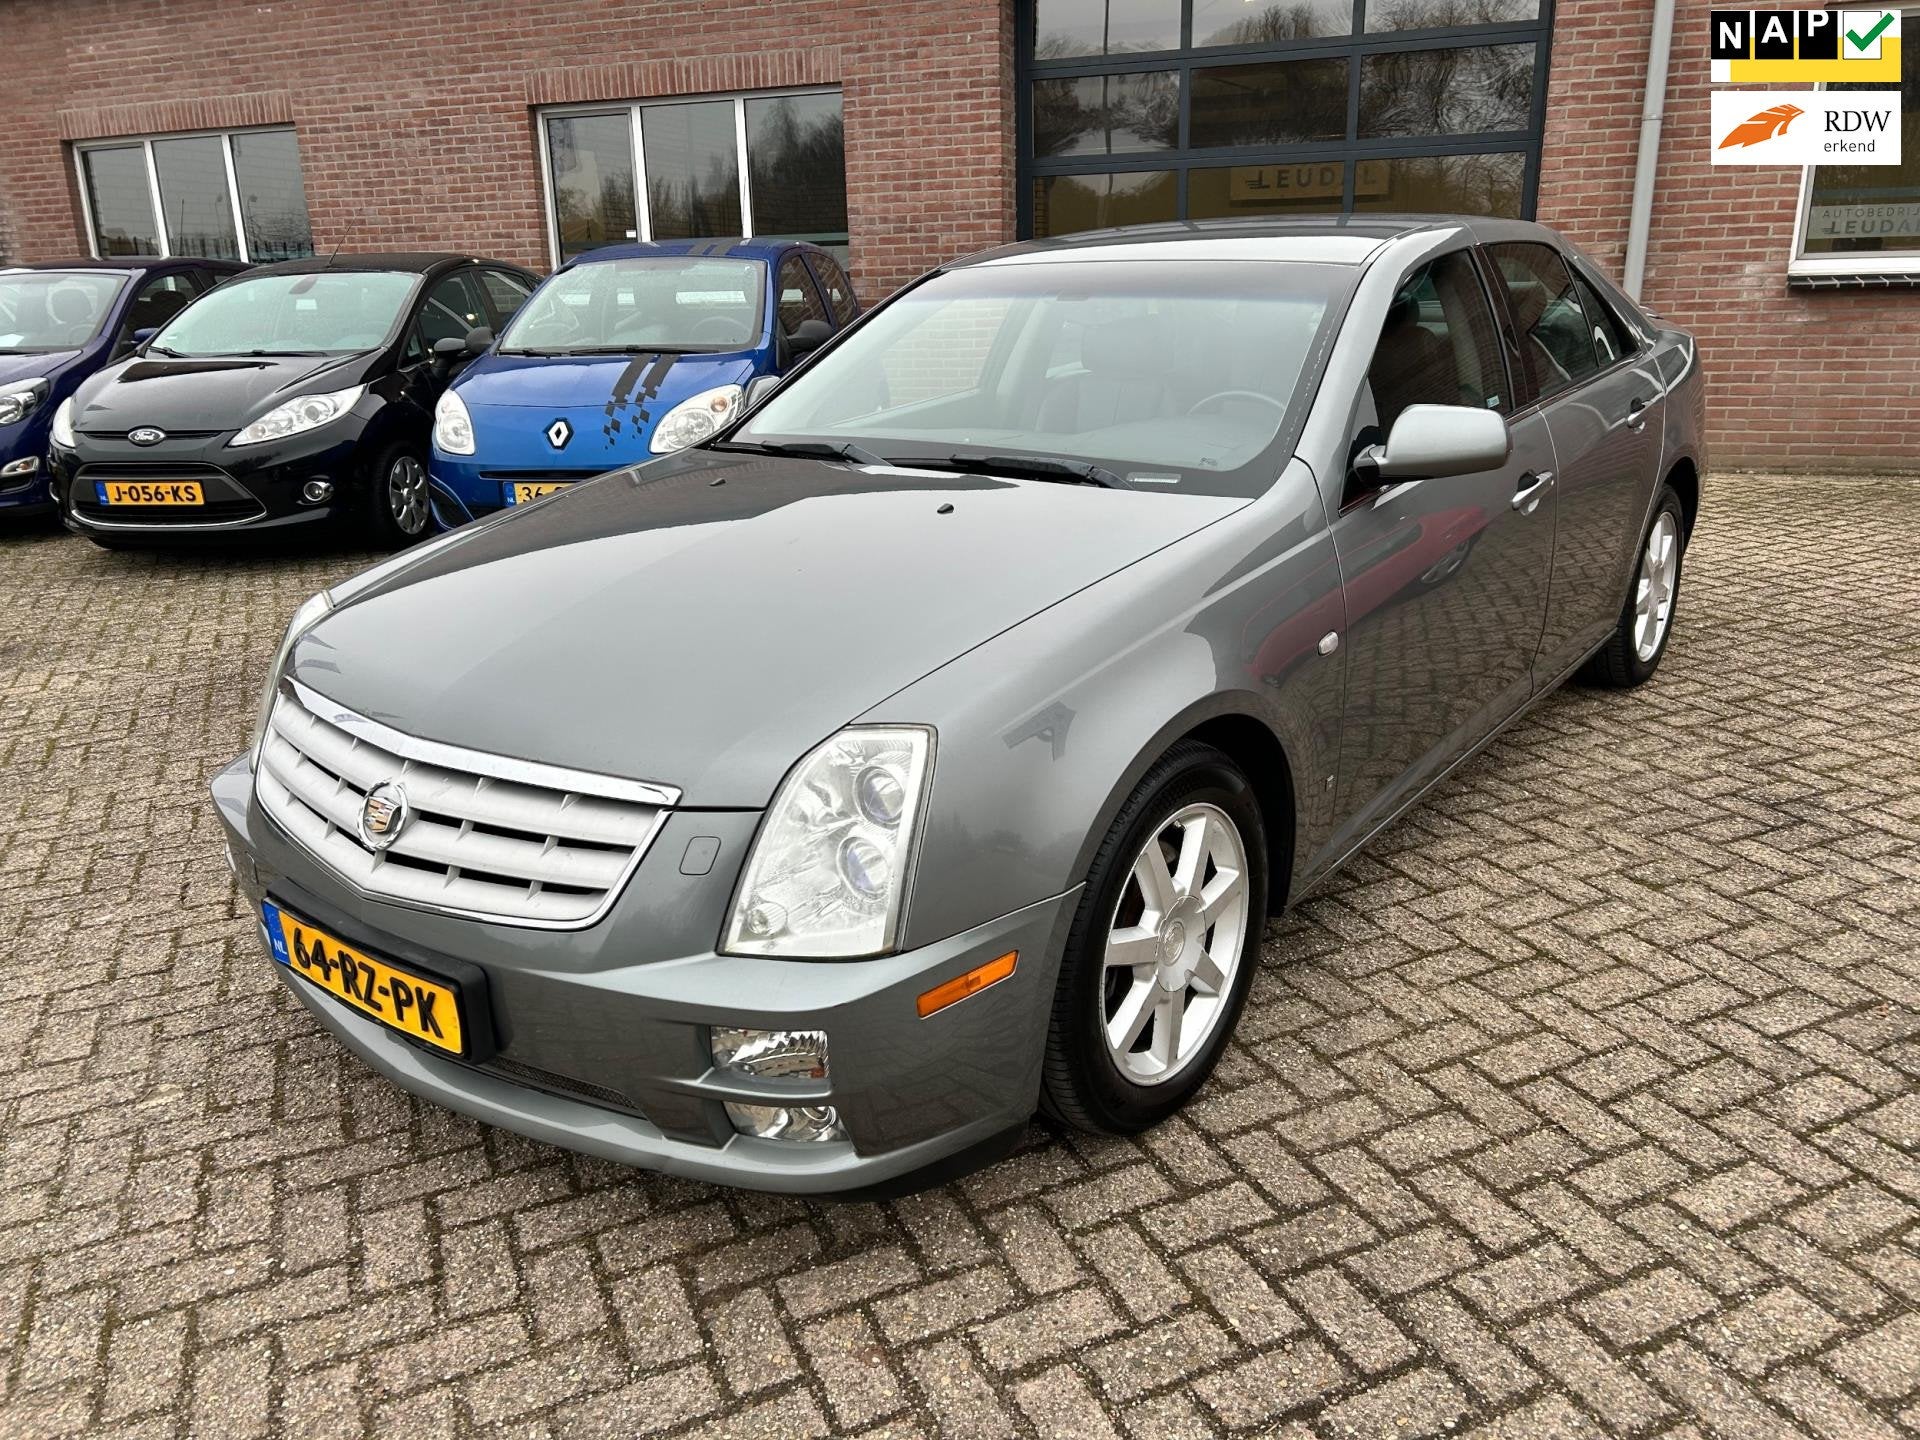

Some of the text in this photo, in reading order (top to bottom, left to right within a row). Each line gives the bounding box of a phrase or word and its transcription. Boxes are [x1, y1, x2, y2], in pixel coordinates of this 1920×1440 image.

[1247, 165, 1377, 190] LEUDL
[114, 485, 197, 502] J-056-KS
[273, 938, 288, 955] NL
[293, 927, 444, 1039] 64-RZ-PK
